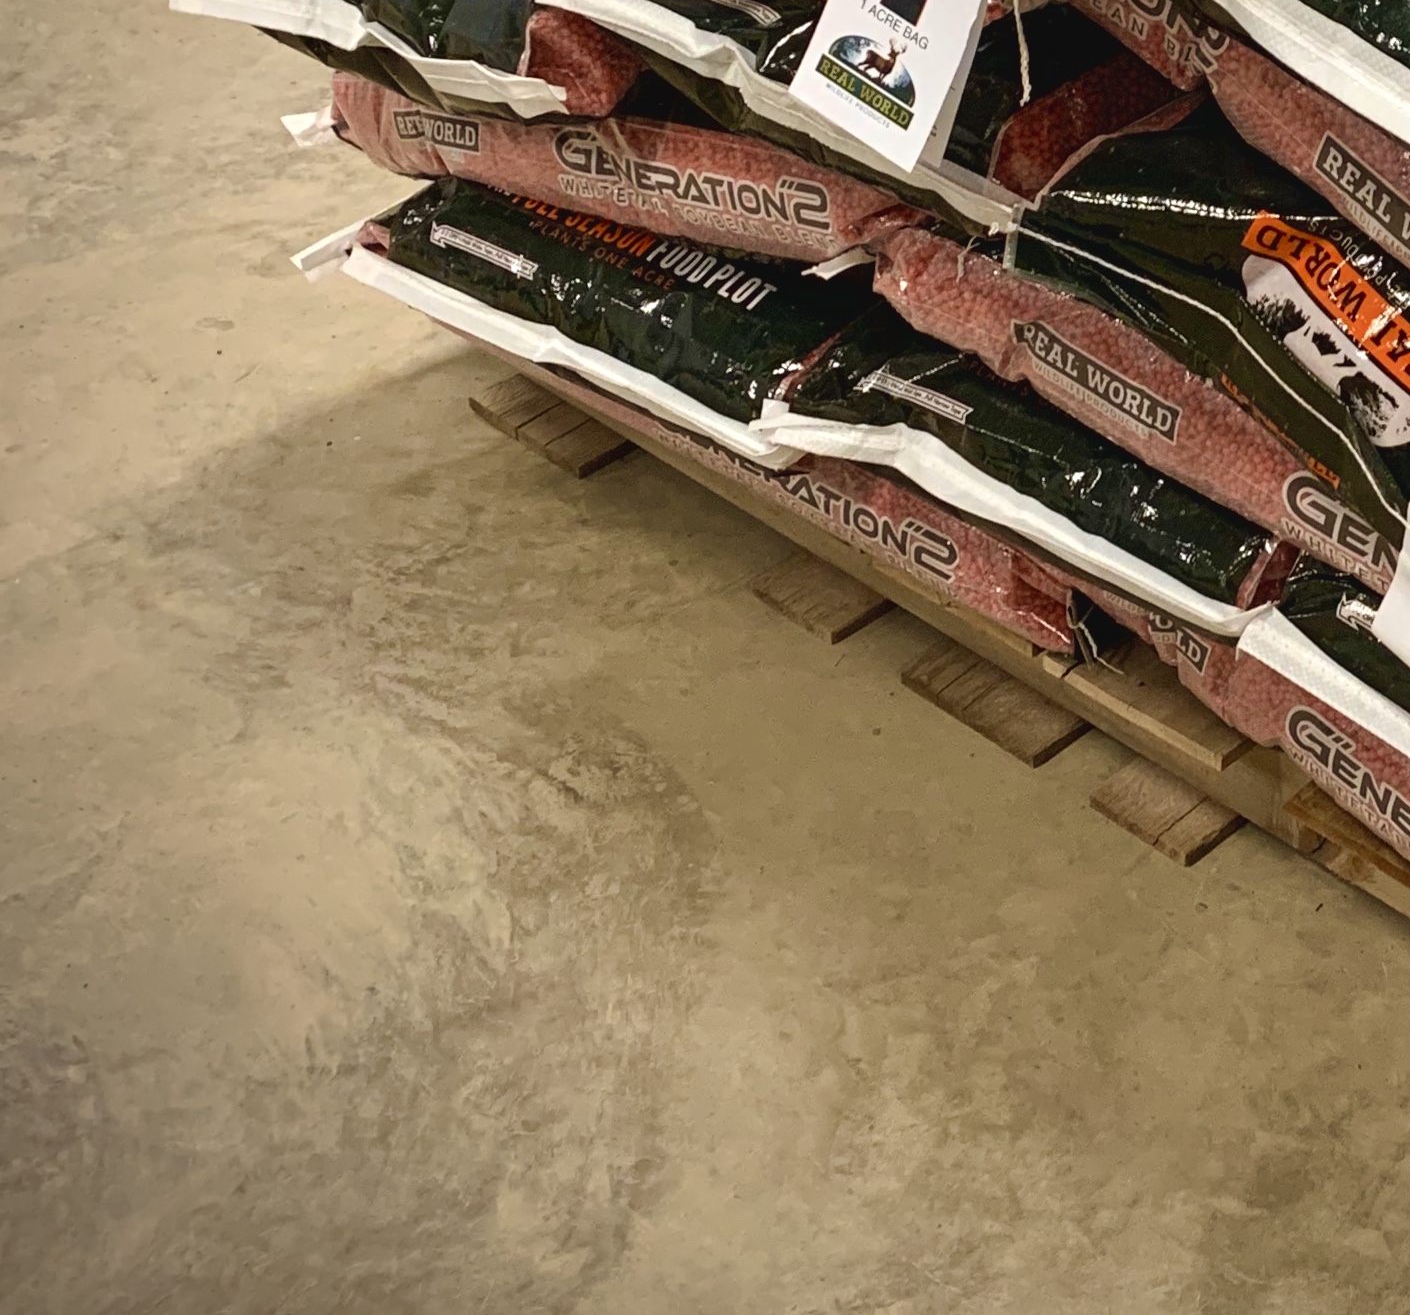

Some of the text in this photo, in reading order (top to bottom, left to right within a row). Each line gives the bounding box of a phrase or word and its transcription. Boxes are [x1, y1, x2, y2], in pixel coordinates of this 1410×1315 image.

[867, 1, 904, 34] ACRE
[902, 24, 931, 51] BAG
[818, 58, 912, 128] REAL WORLD
[422, 119, 478, 148] WORLD
[552, 127, 832, 231] GENERATION2
[1322, 145, 1393, 224] REAL
[531, 221, 590, 252] PLANTS
[593, 247, 629, 270] ONE
[646, 240, 712, 285] FOOD
[702, 264, 779, 313] PLOT
[1256, 223, 1368, 323] WORLD
[1022, 324, 1174, 433] REAL WORLD
